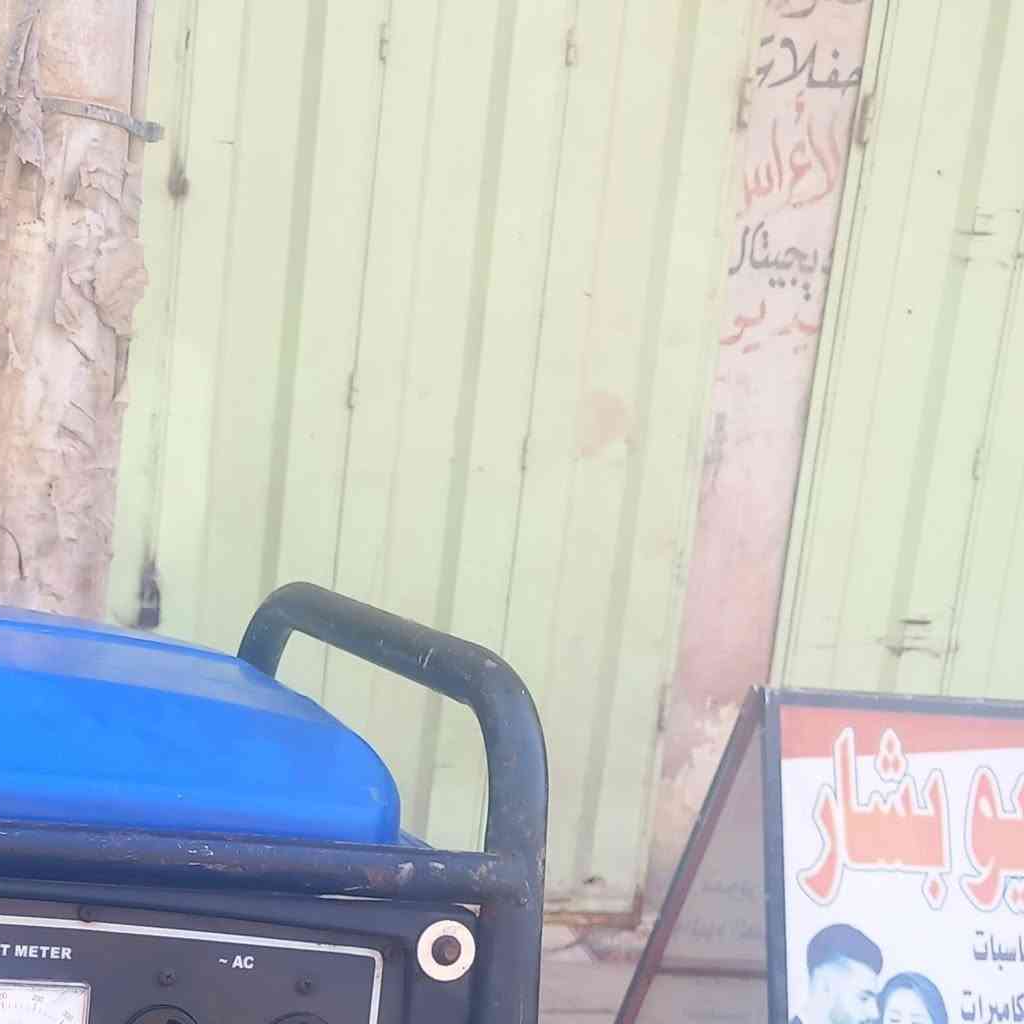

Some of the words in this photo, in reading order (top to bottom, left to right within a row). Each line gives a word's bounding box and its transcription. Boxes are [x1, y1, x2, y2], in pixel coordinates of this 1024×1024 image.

[798, 728, 951, 909] بشار
[14, 945, 72, 960] METER
[232, 955, 255, 969] AC
